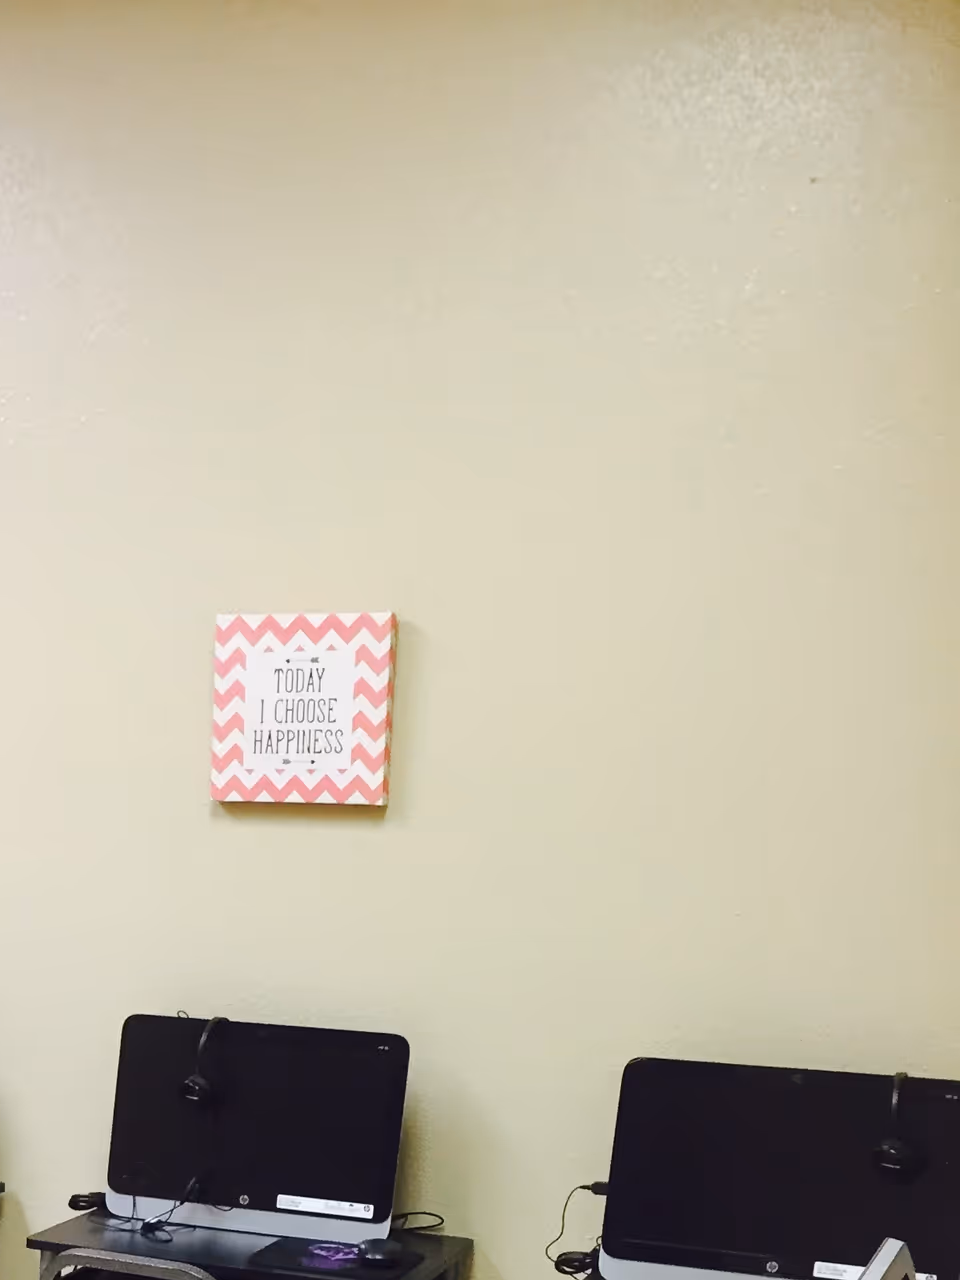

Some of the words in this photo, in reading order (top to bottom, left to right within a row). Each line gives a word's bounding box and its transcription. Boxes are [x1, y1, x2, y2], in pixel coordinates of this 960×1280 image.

[274, 667, 326, 694] TODAY
[260, 699, 265, 724] I
[274, 698, 338, 724] CHOOSE
[253, 729, 344, 755] HAPPINESS
